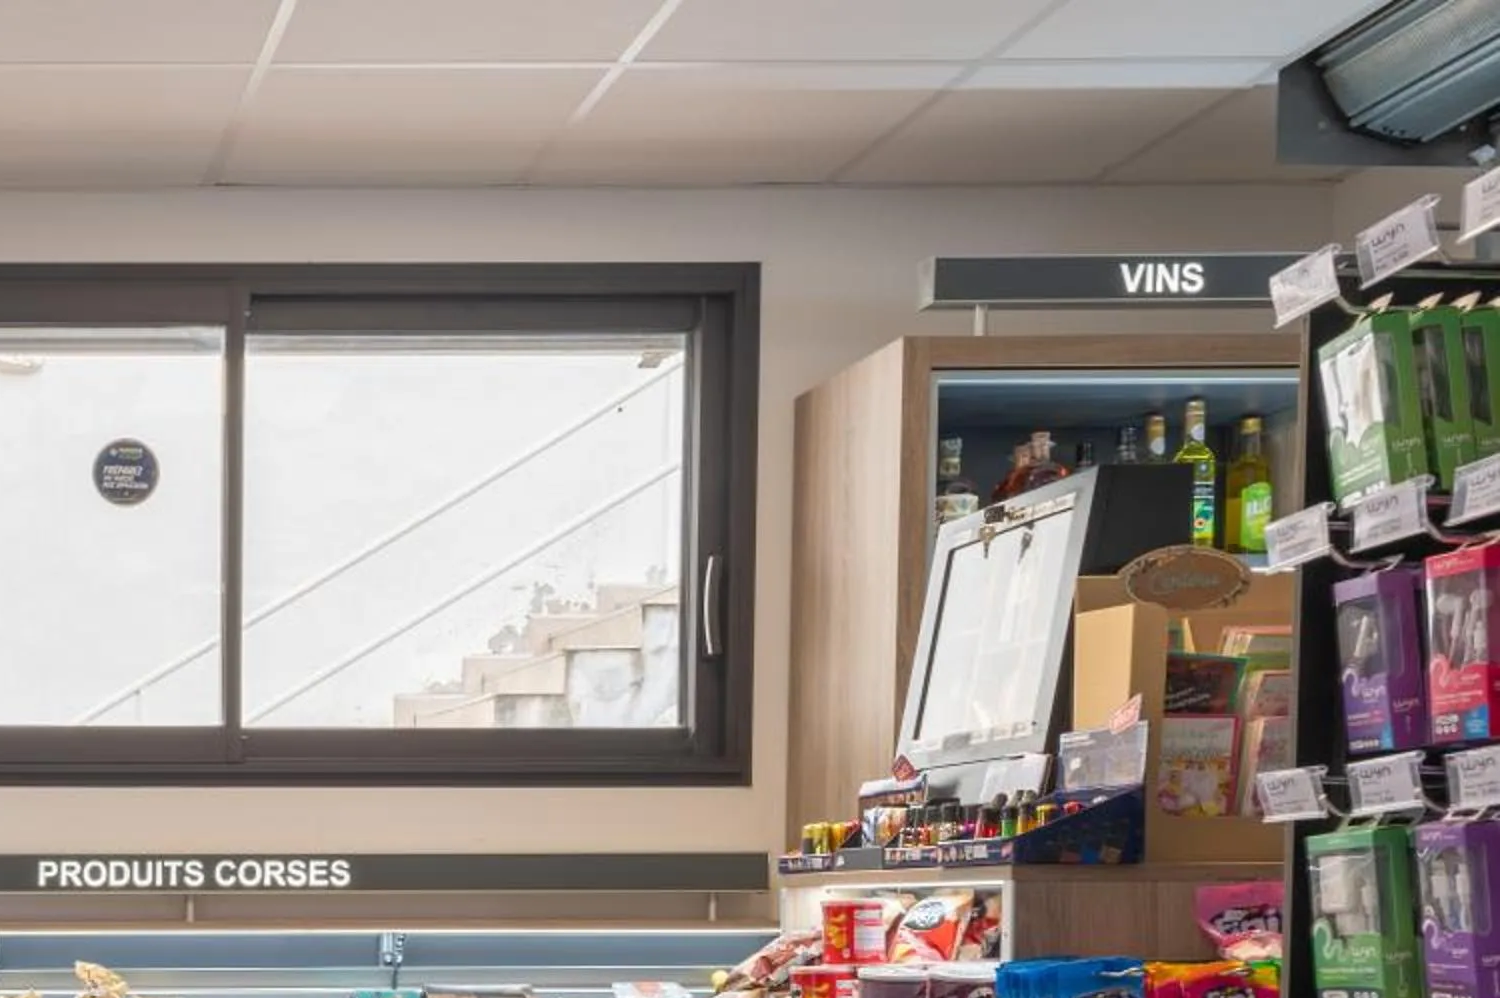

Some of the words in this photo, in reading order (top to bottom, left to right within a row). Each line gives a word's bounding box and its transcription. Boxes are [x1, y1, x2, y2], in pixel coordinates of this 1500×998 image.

[1120, 262, 1205, 294] VINS
[37, 860, 206, 888] PRODUITS
[214, 860, 352, 888] CORSES
